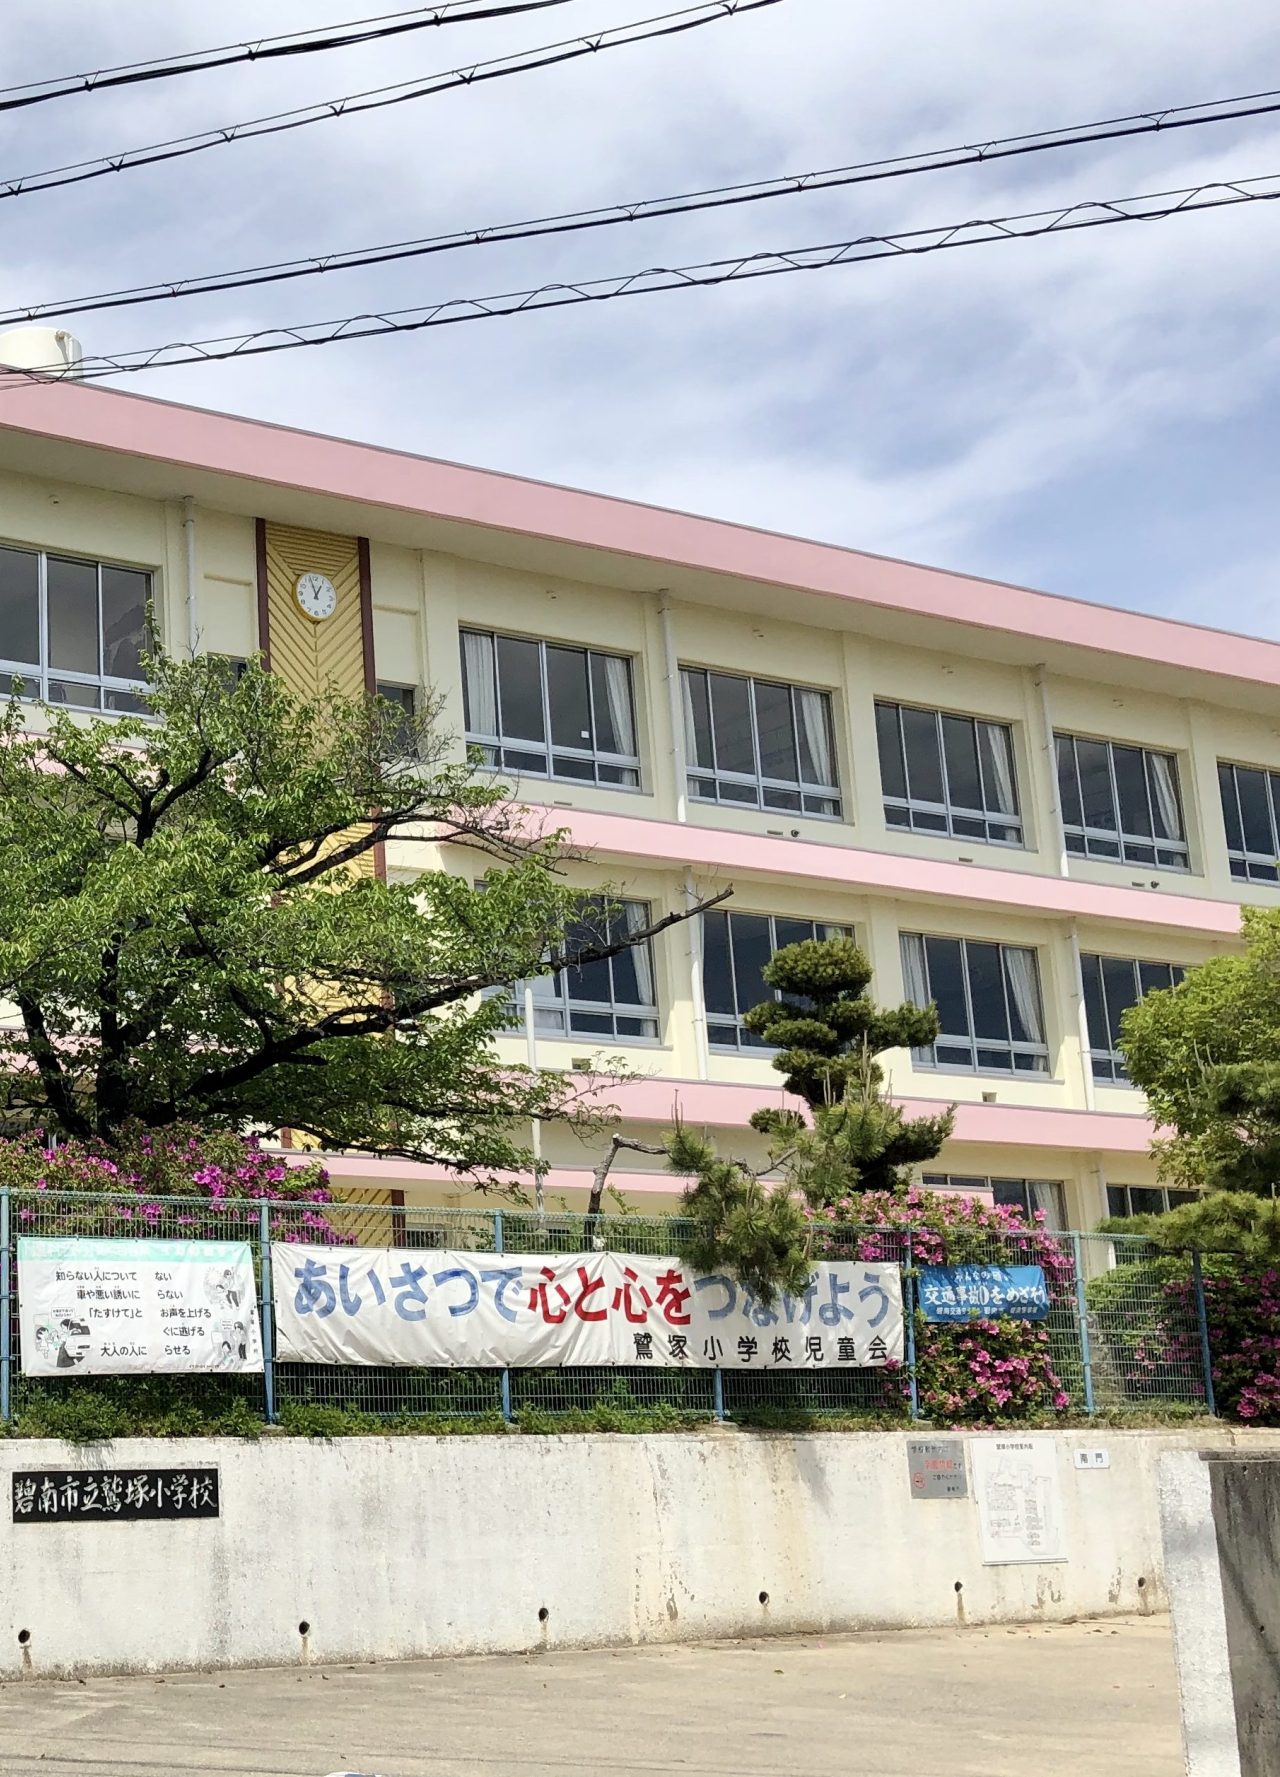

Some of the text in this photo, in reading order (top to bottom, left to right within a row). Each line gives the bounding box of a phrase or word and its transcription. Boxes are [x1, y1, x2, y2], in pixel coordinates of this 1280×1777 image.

[56, 1271, 172, 1281] 知らない人について ない
[157, 1290, 183, 1300] らない
[89, 1308, 212, 1318] 「たすけて」と お声を上げる
[101, 1345, 191, 1357] 大人の人に らせる
[633, 1332, 888, 1363] 鷲塚小学校児童会
[1080, 1452, 1104, 1465] 南門
[14, 1473, 218, 1515] 碧南市立鷲塚小学校
